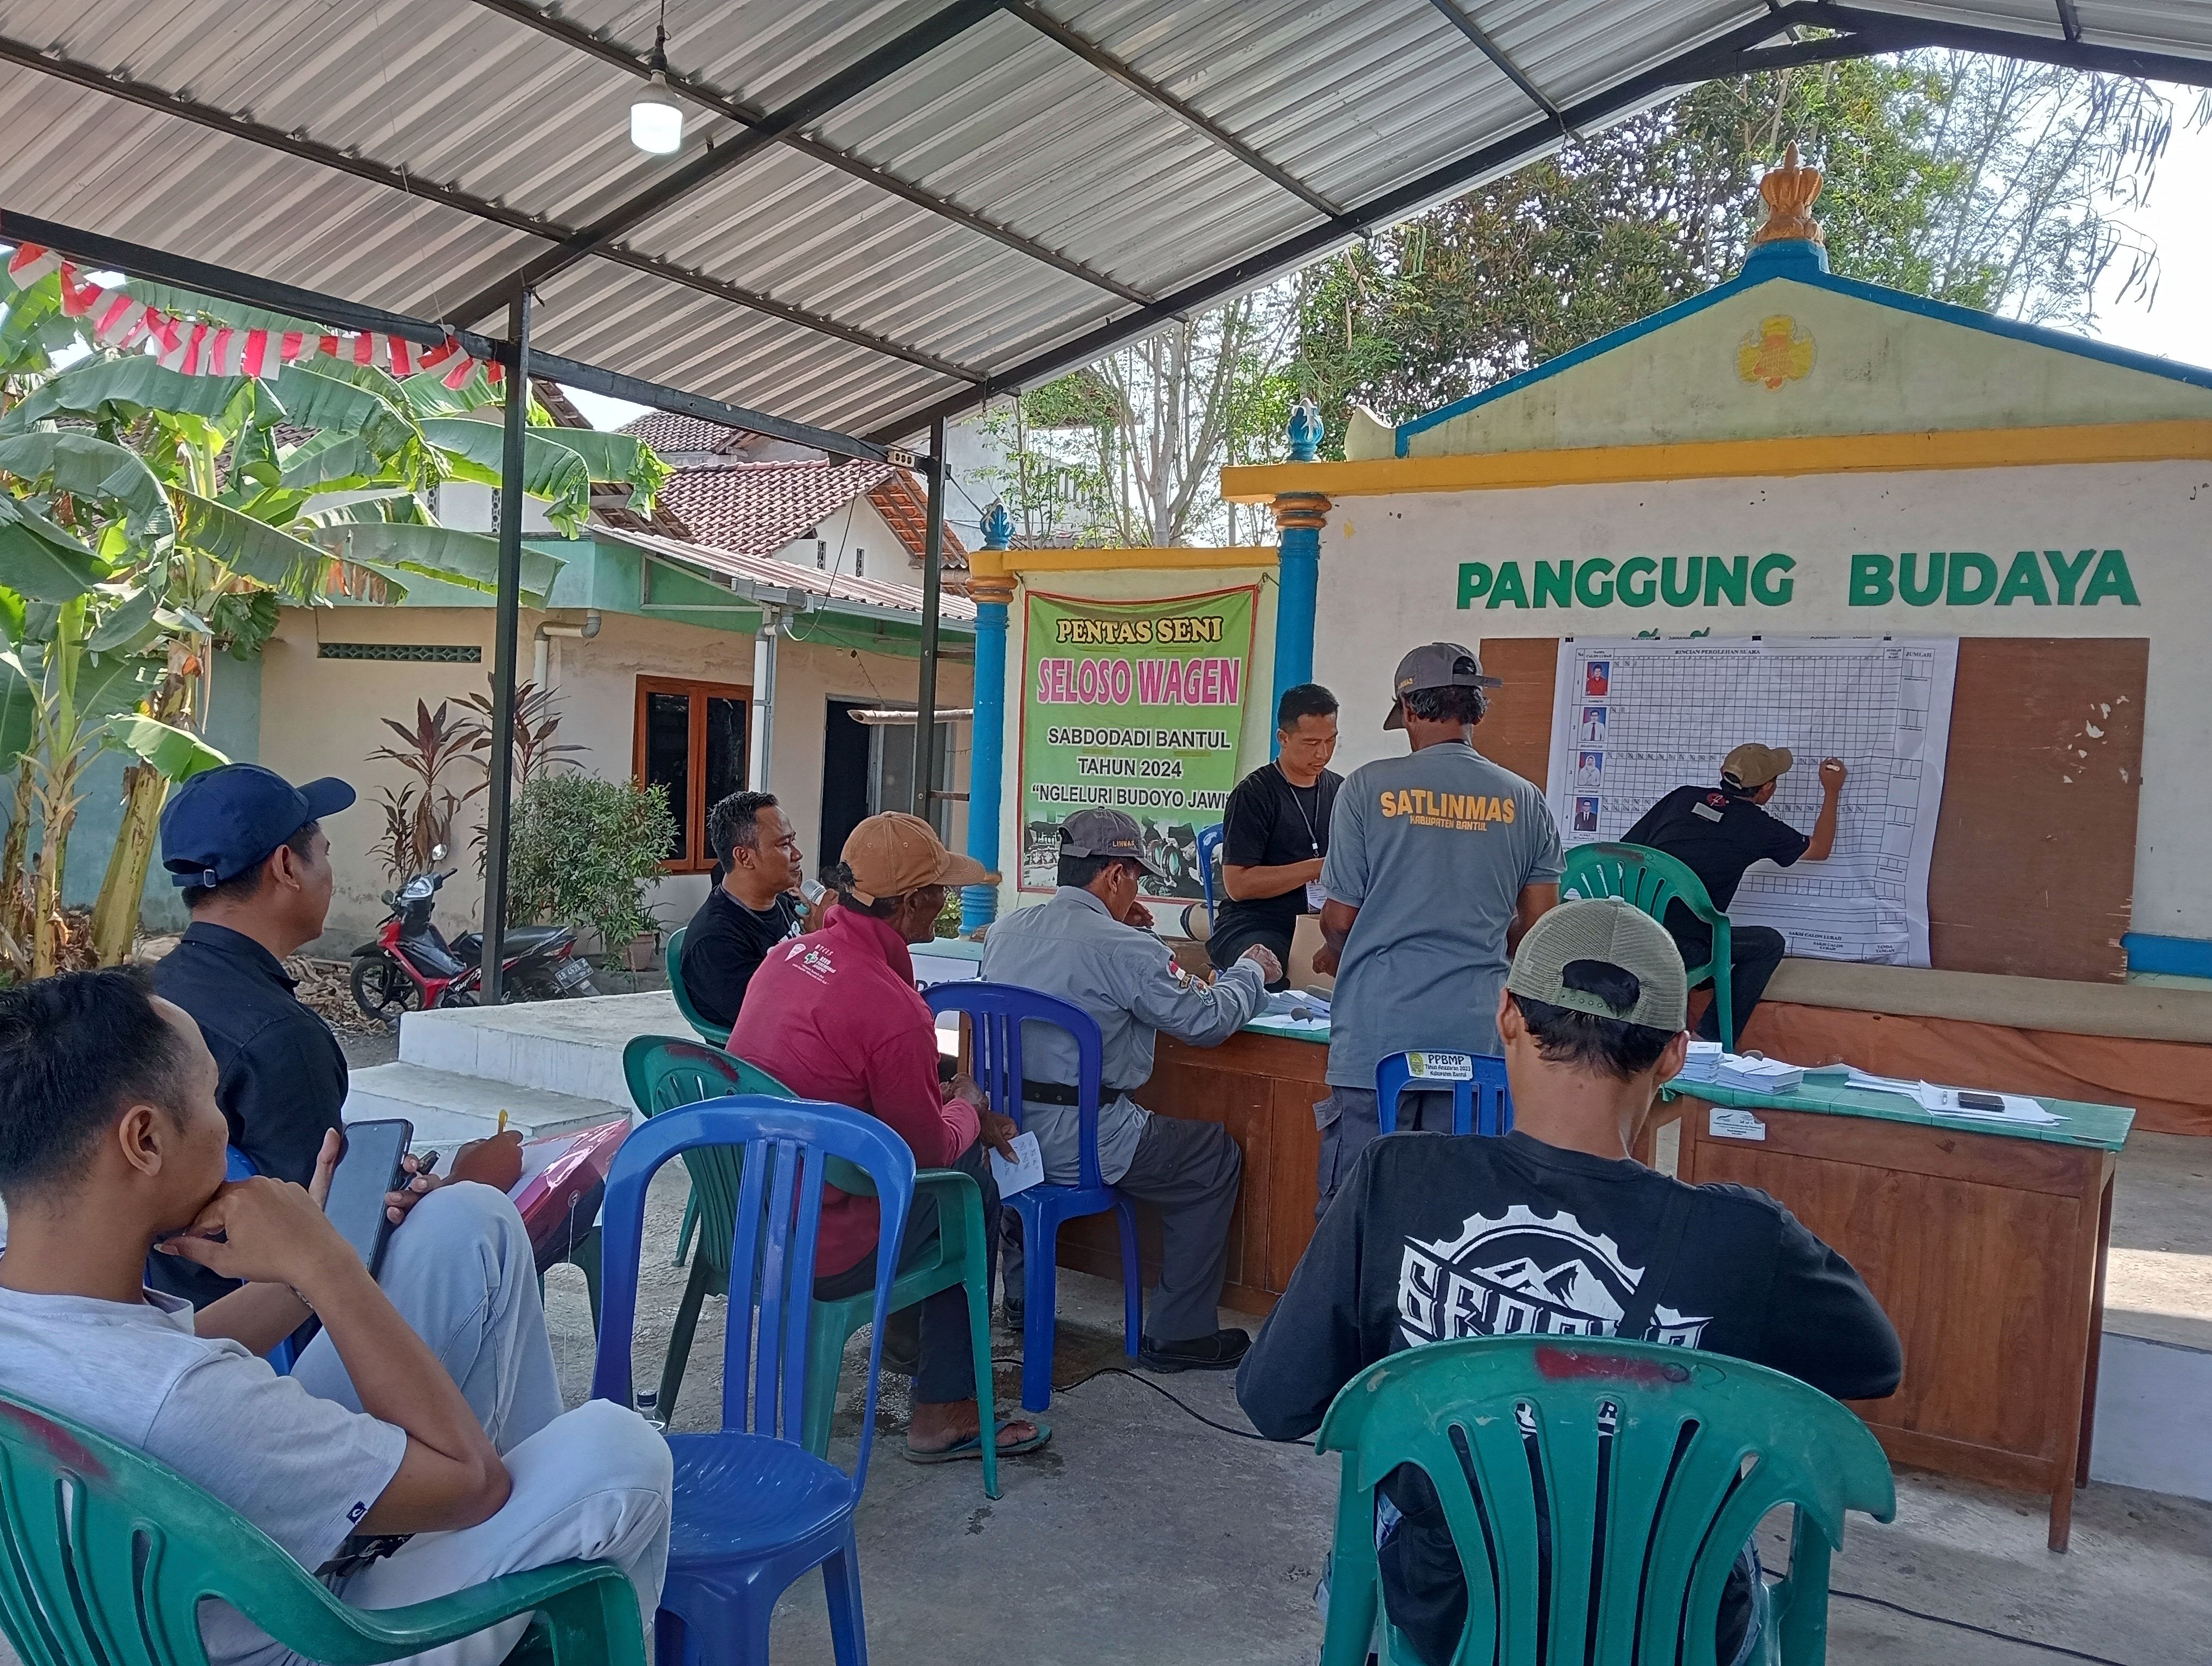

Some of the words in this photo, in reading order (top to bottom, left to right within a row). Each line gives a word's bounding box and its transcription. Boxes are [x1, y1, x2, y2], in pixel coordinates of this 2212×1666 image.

[1457, 553, 1795, 610] PANGGUNG
[1848, 548, 2142, 606] BUDAYA
[1056, 618, 1152, 644] PENTAS
[1156, 616, 1224, 644] SENI
[1038, 658, 1132, 704] SELOSO
[1137, 658, 1241, 705] WAGEN
[1048, 728, 1151, 747] SABDODADI
[1156, 731, 1231, 748] BANTUL
[1078, 758, 1136, 776] TAHUN
[1141, 760, 1182, 777] 2024
[1117, 789, 1184, 807] BUDOYO
[1380, 789, 1515, 824] SATLINMAS
[1410, 815, 1455, 829] KABUPATEN
[1456, 821, 1488, 832] BANTUL
[1427, 1054, 1465, 1065] PPBMP
